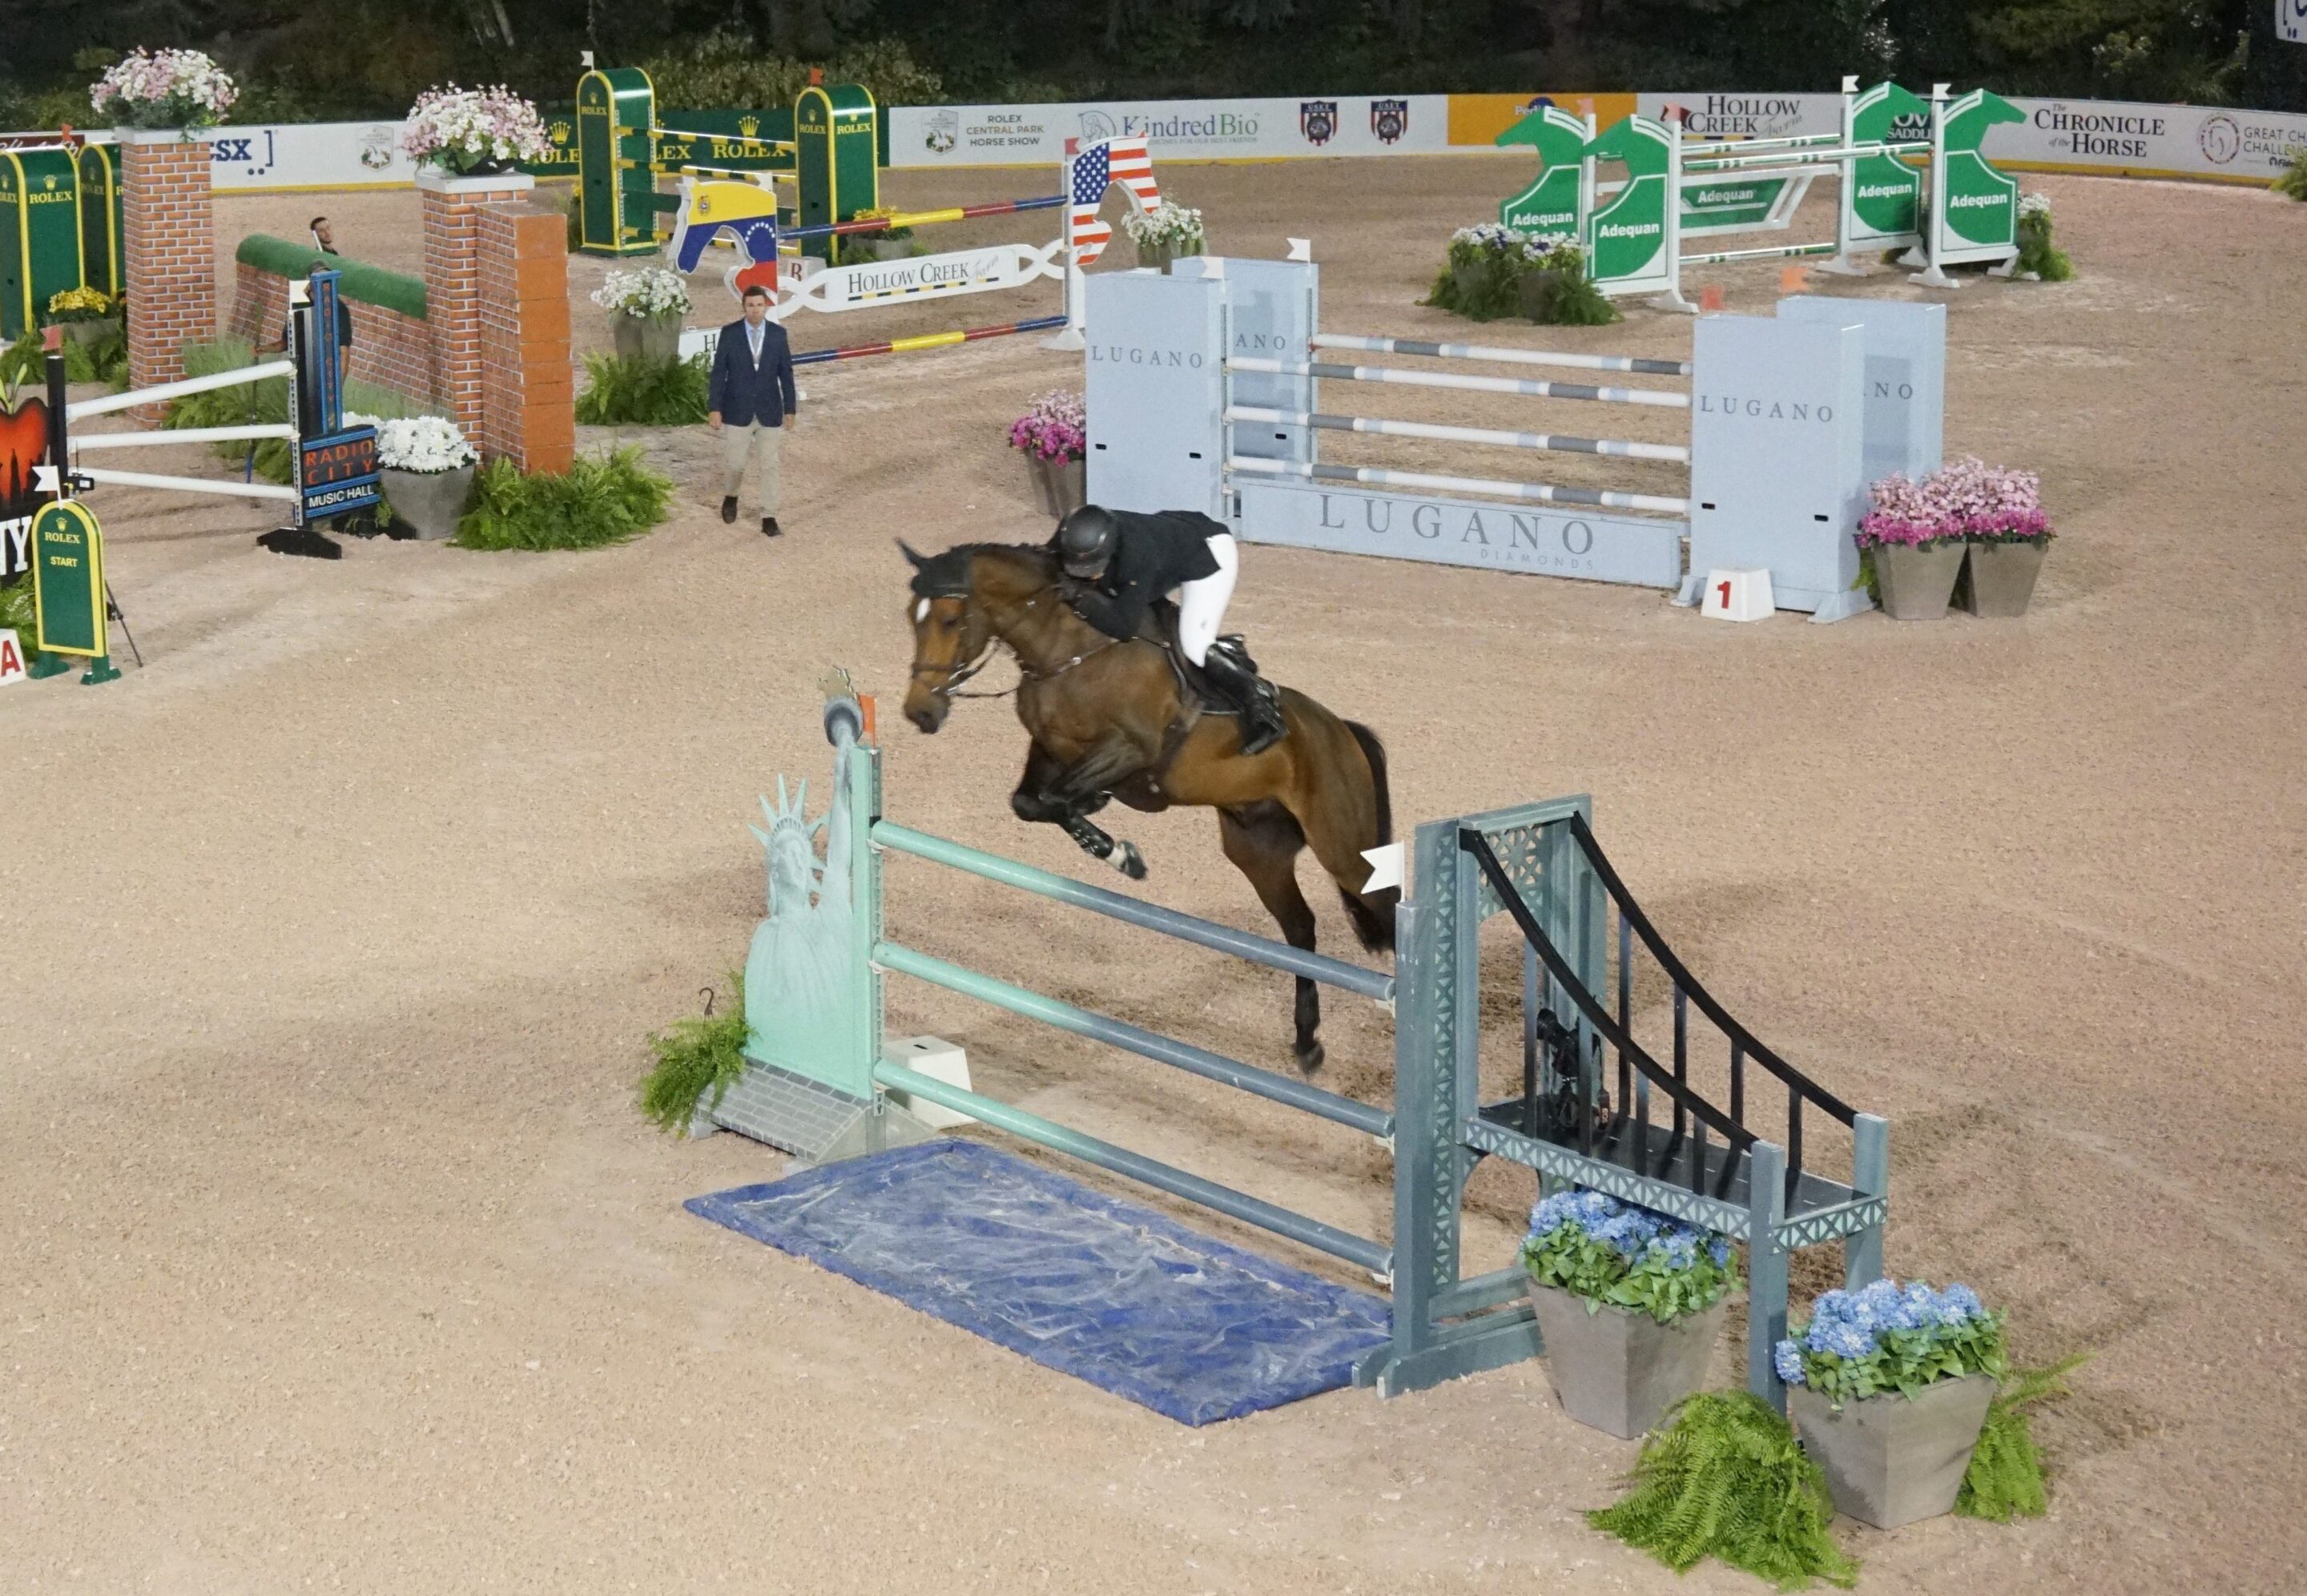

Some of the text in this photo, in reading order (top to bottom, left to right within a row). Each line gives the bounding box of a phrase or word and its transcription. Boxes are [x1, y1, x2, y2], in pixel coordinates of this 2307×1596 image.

[581, 106, 607, 115] ROLEX
[1706, 95, 1801, 116] HOLLOW
[988, 115, 1022, 123] ROLEX
[1688, 112, 1758, 133] CREEK
[2034, 108, 2165, 136] CHRONICLE
[799, 124, 826, 135] ROLEX
[837, 123, 872, 135] ROLEX
[966, 125, 1045, 135] CENTRAL PARK
[2244, 127, 2284, 141] GREAT
[970, 137, 1040, 147] HORSE SHOW
[2071, 132, 2147, 158] HORSE
[29, 191, 73, 204] ROLEX
[1697, 190, 1754, 203] Adequan
[1858, 183, 1913, 198] Adequan
[1950, 194, 2008, 208] Adequan
[1512, 212, 1573, 227] Adequan
[1599, 223, 1660, 238] Adequan
[848, 269, 916, 294] HOLLOW
[920, 263, 969, 283] CREEK
[1091, 345, 1202, 368] LUGANO
[1700, 396, 1834, 423] LUGANO
[305, 439, 372, 467] RADIO
[307, 460, 372, 484] CITY
[308, 484, 374, 508] MUSIC HALL
[1319, 494, 1594, 555] LUGANO
[44, 531, 81, 544] ROLEX
[50, 556, 78, 567] START
[1480, 548, 1594, 571] DIAMONDS
[1717, 581, 1731, 609] 1
[1, 639, 21, 677] A
